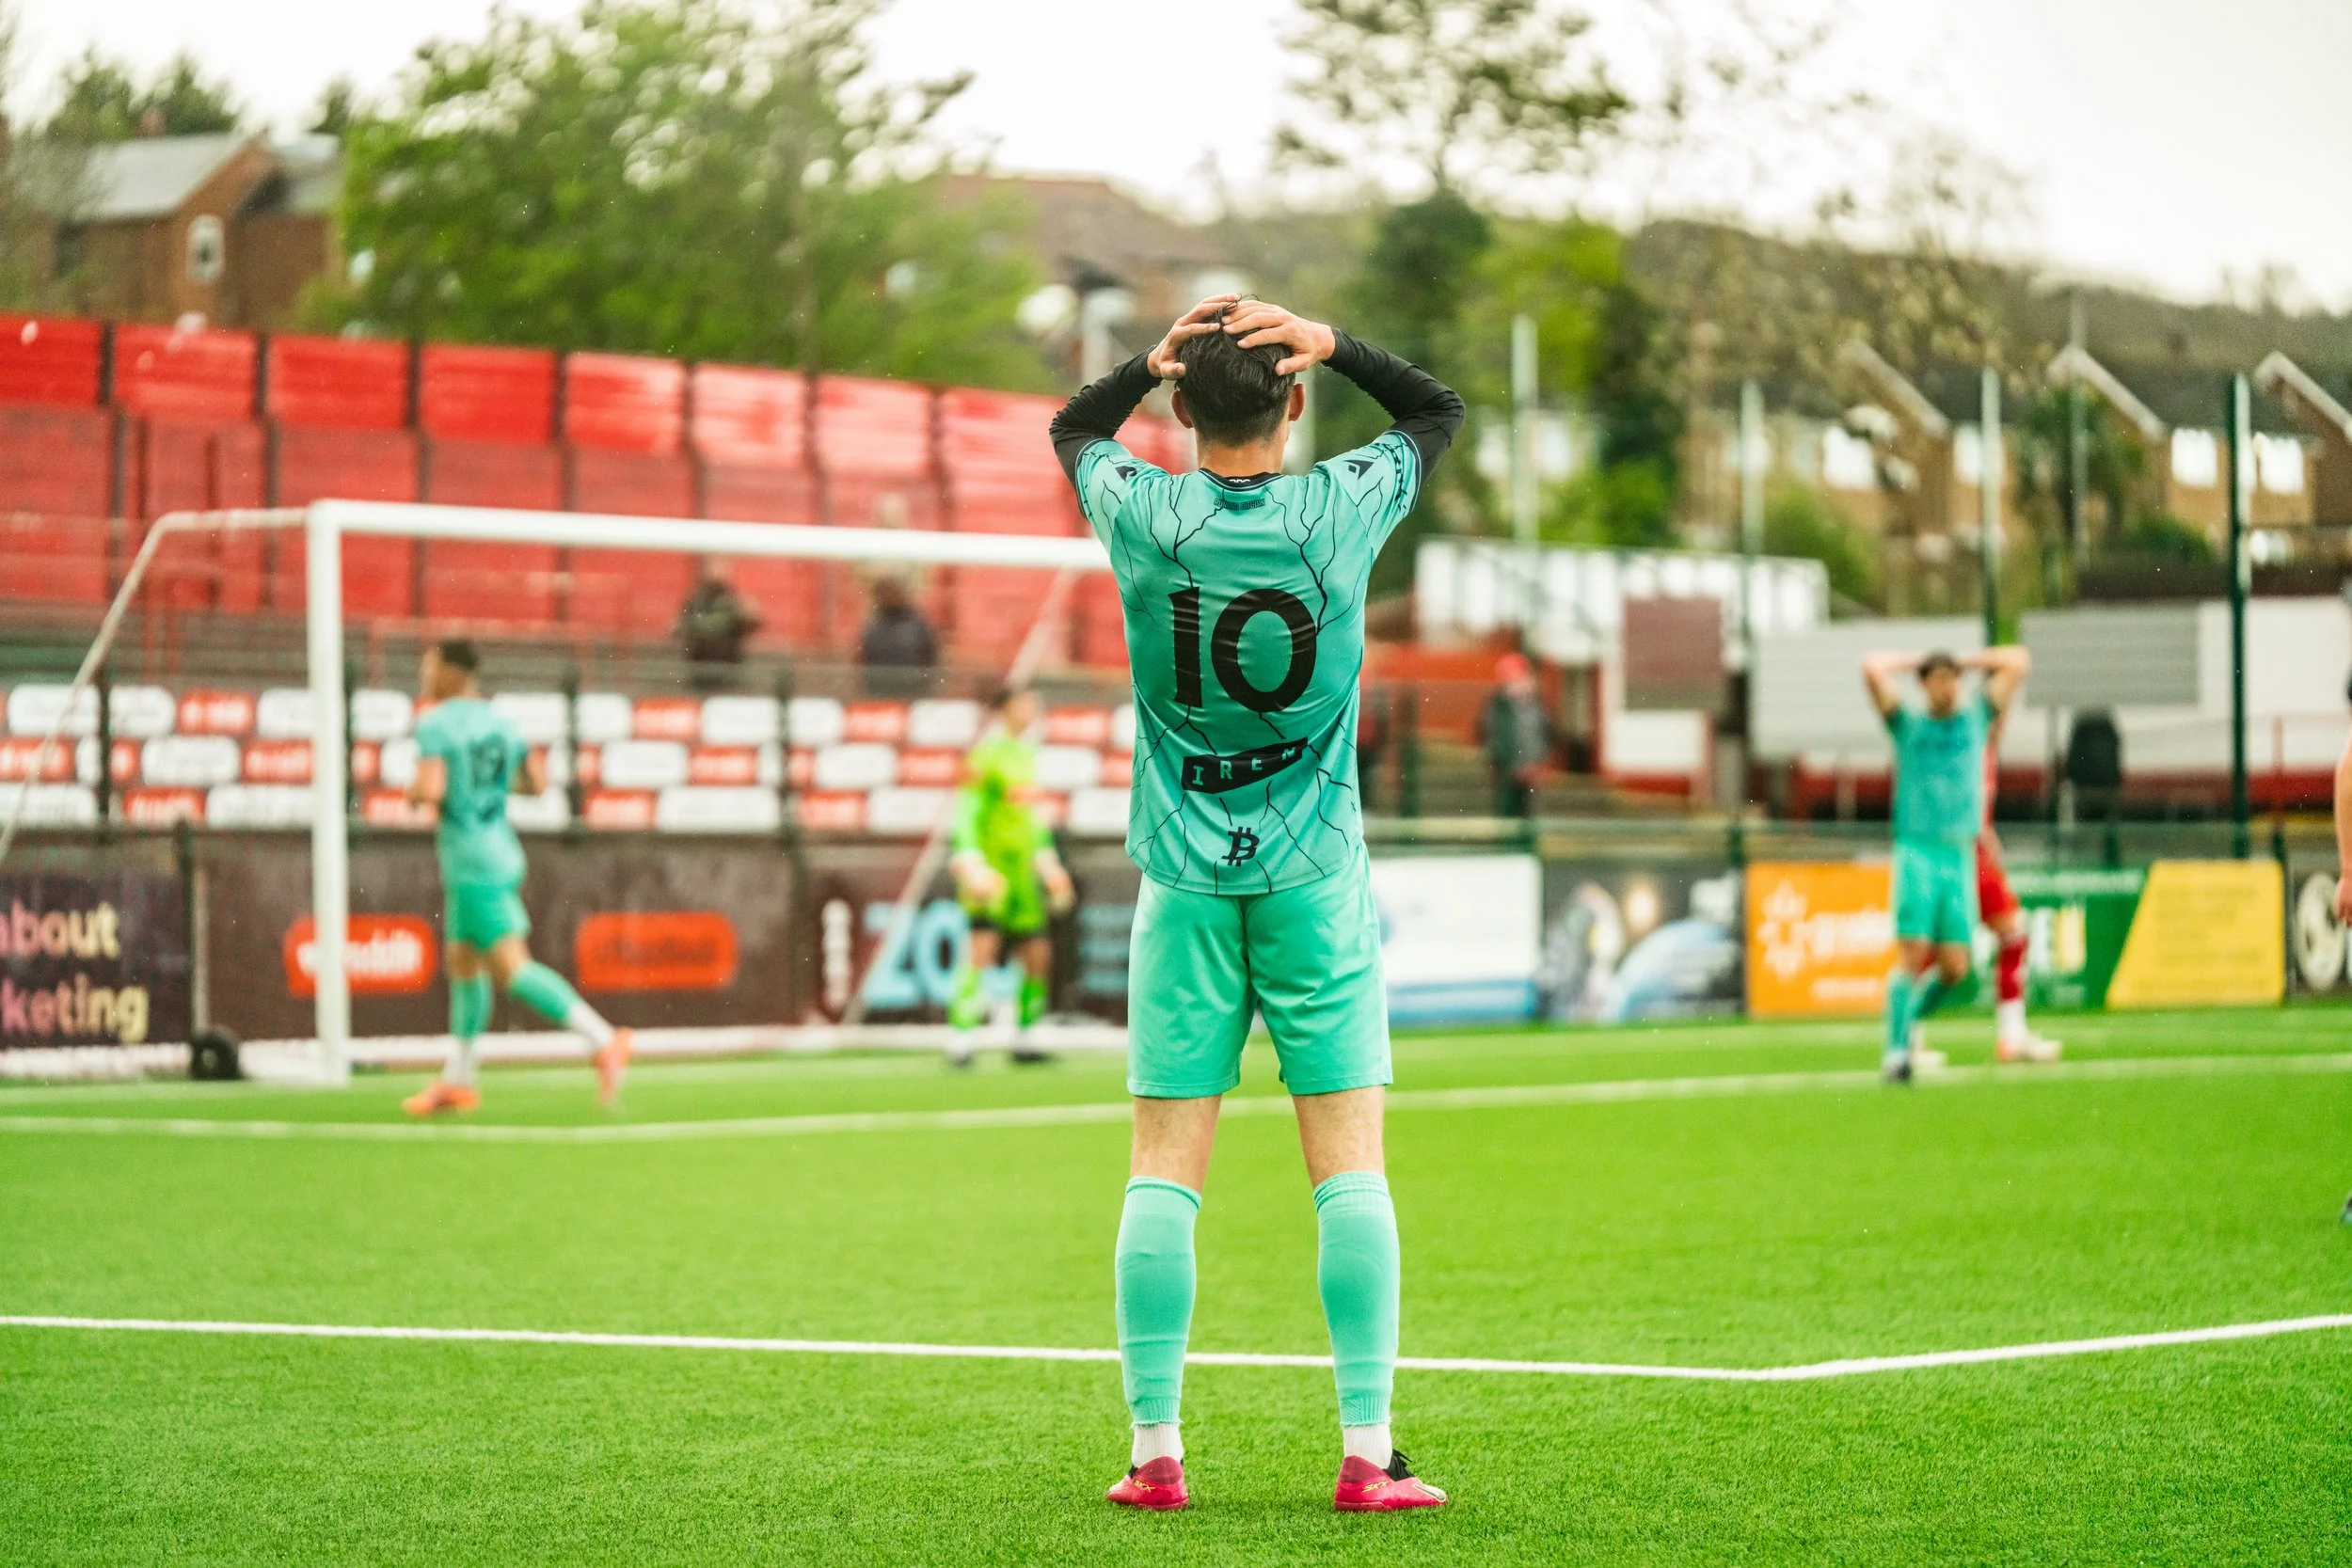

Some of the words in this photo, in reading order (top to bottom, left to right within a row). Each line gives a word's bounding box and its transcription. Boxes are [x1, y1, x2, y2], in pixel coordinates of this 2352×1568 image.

[1168, 586, 1318, 713] 10
[1191, 747, 1296, 786] IREN
[1361, 1480, 1390, 1493] SKX
